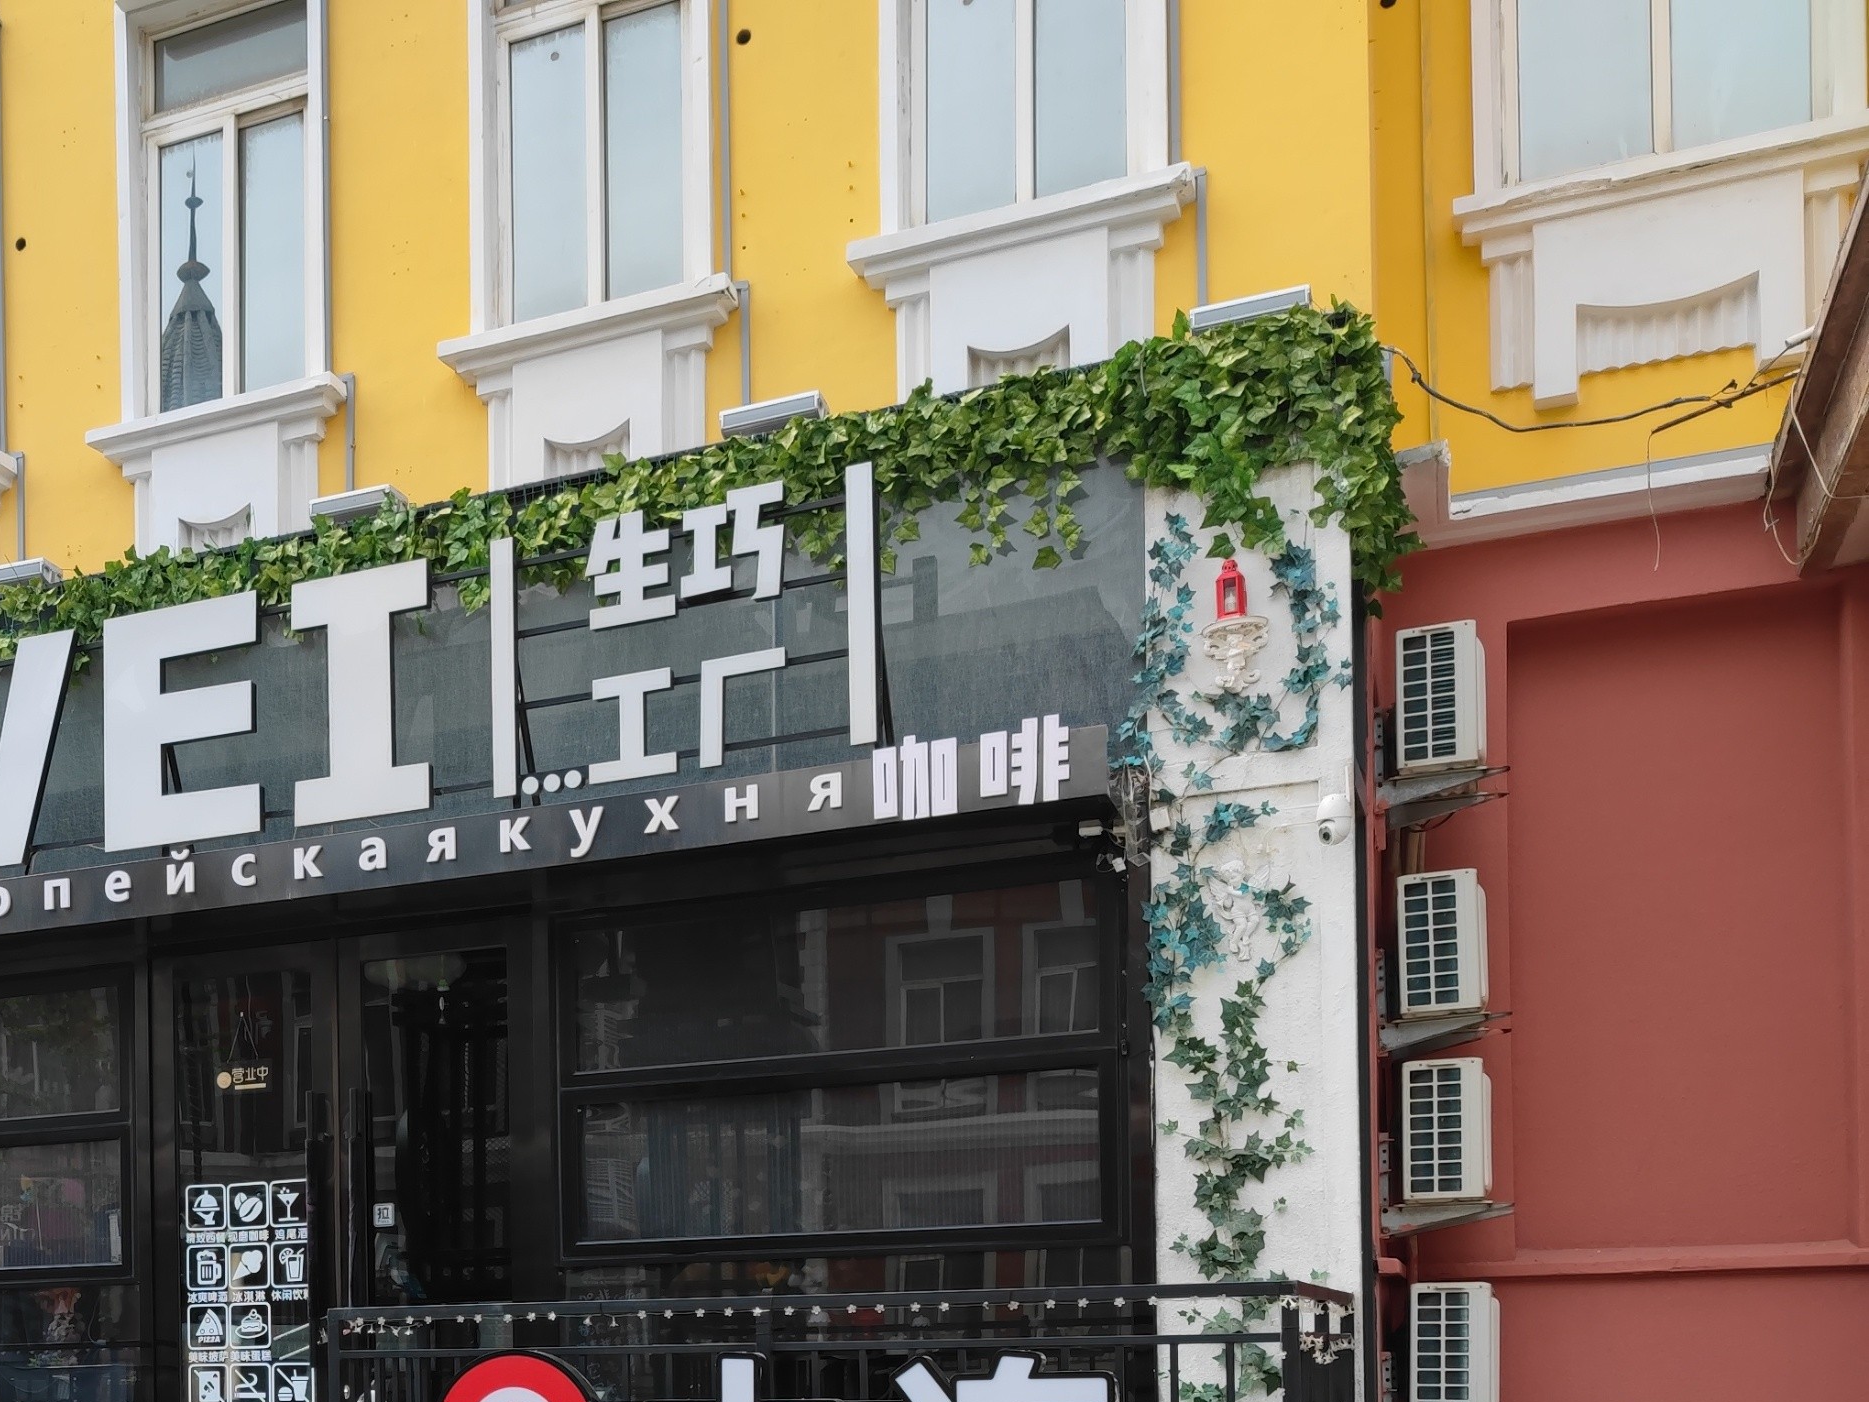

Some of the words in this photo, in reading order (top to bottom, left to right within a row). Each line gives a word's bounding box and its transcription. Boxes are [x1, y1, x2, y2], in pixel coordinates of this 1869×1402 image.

[585, 480, 786, 633] 生巧
[585, 647, 788, 786] 工厂
[872, 712, 1078, 823] 咖啡
[232, 1066, 269, 1083] 营业中
[185, 1231, 226, 1244] 精致西餐
[228, 1229, 270, 1242] 现磨咖啡
[187, 1291, 228, 1303] 冰爽啤酒
[232, 1290, 266, 1302] 冰淇淋
[230, 1350, 272, 1362] 美味蛋糕
